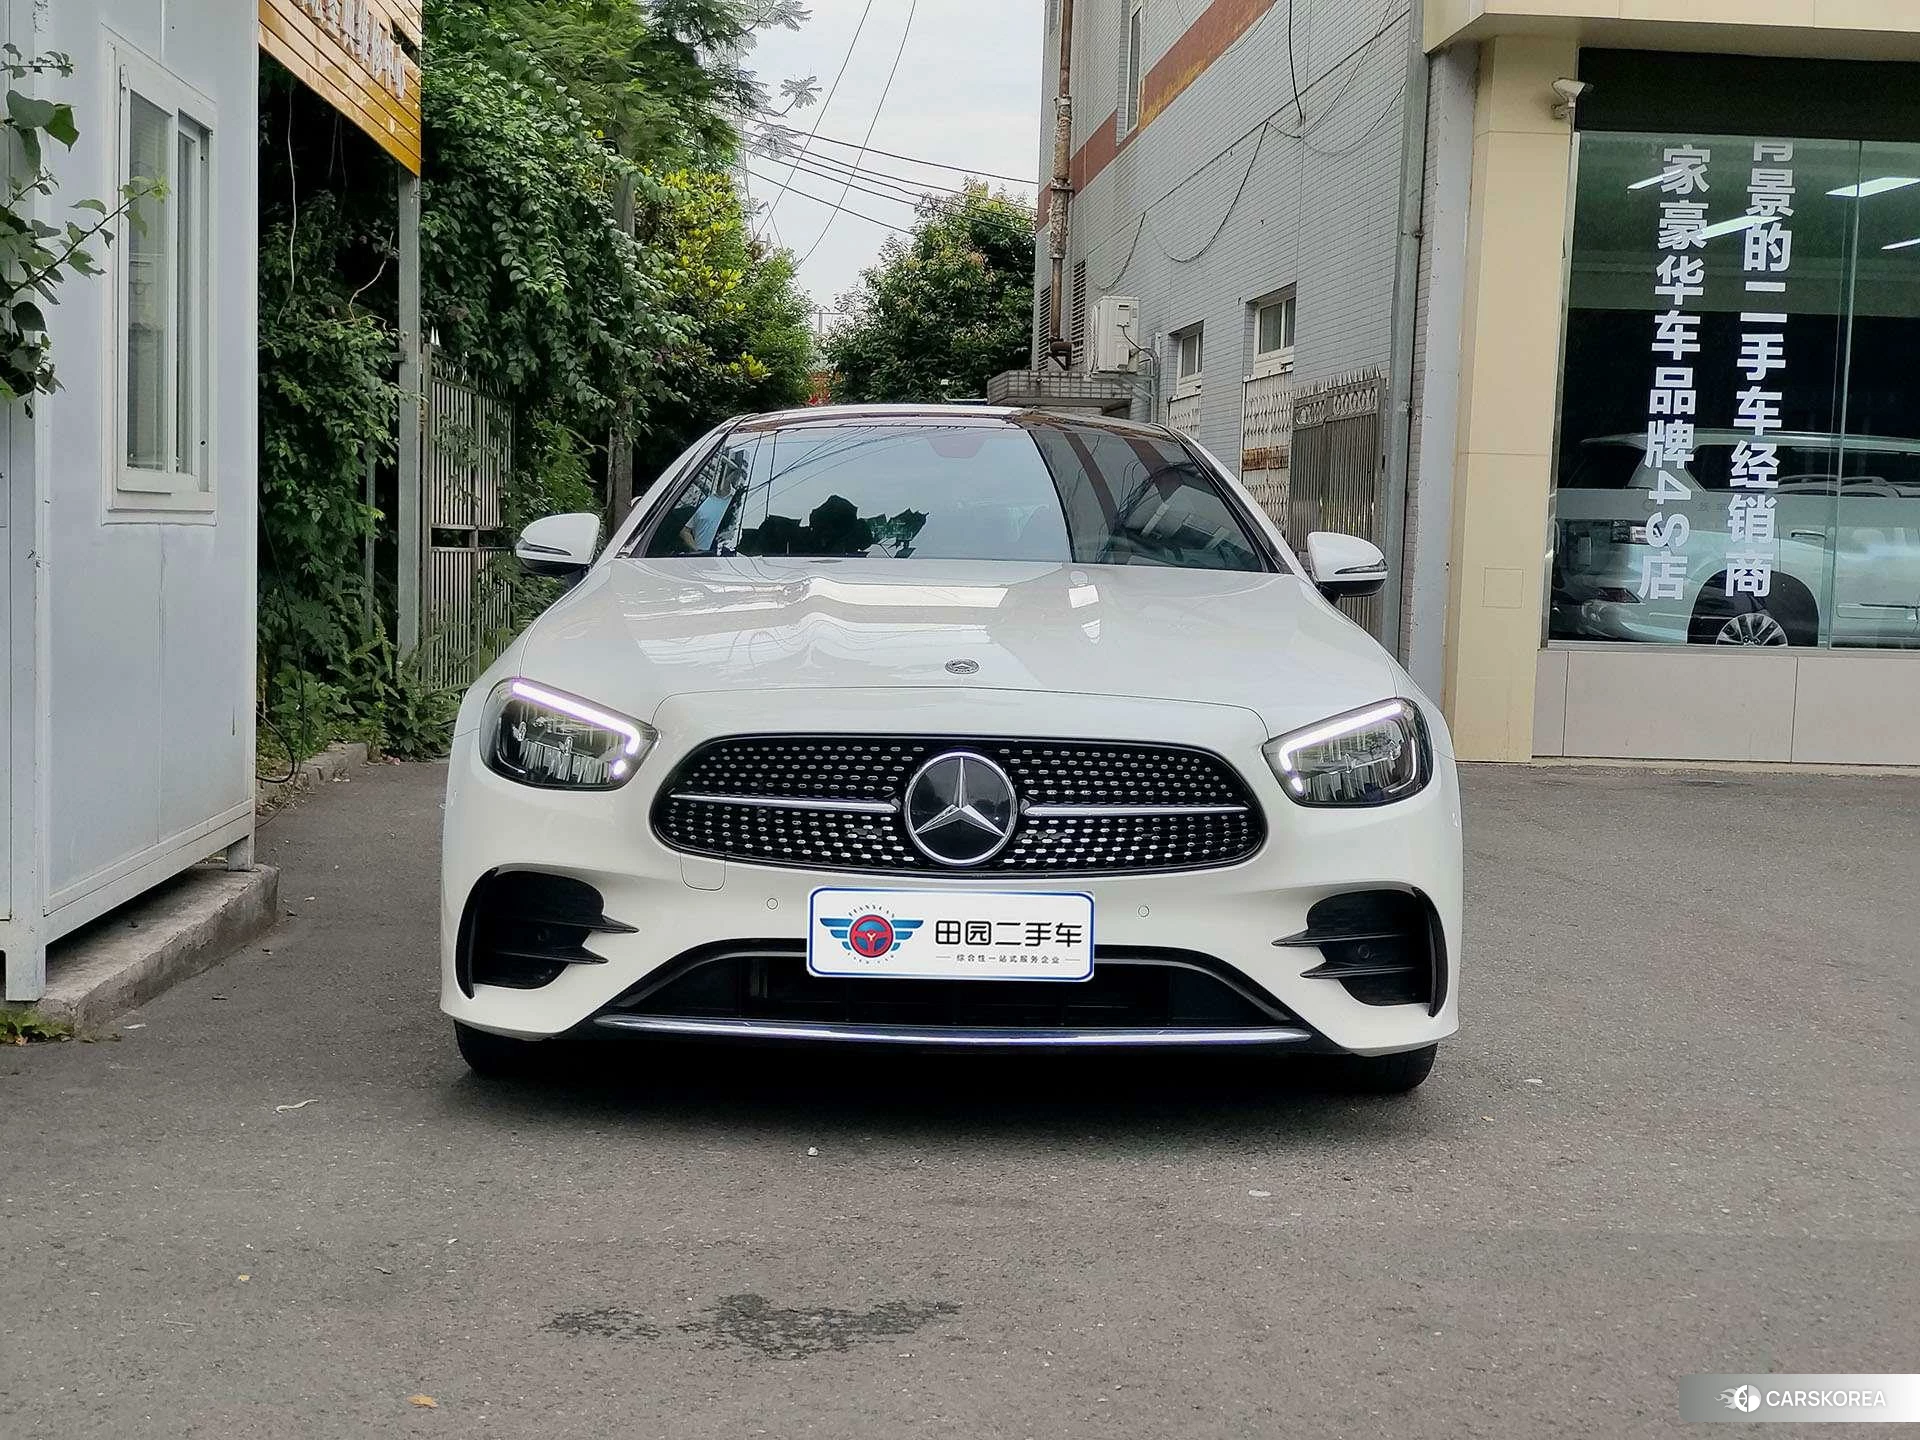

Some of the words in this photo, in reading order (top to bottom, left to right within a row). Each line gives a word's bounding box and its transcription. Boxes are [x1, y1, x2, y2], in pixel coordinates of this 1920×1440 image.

[1637, 144, 1711, 600] 家豪华车品牌4S店
[935, 920, 1083, 948] 田园二手车
